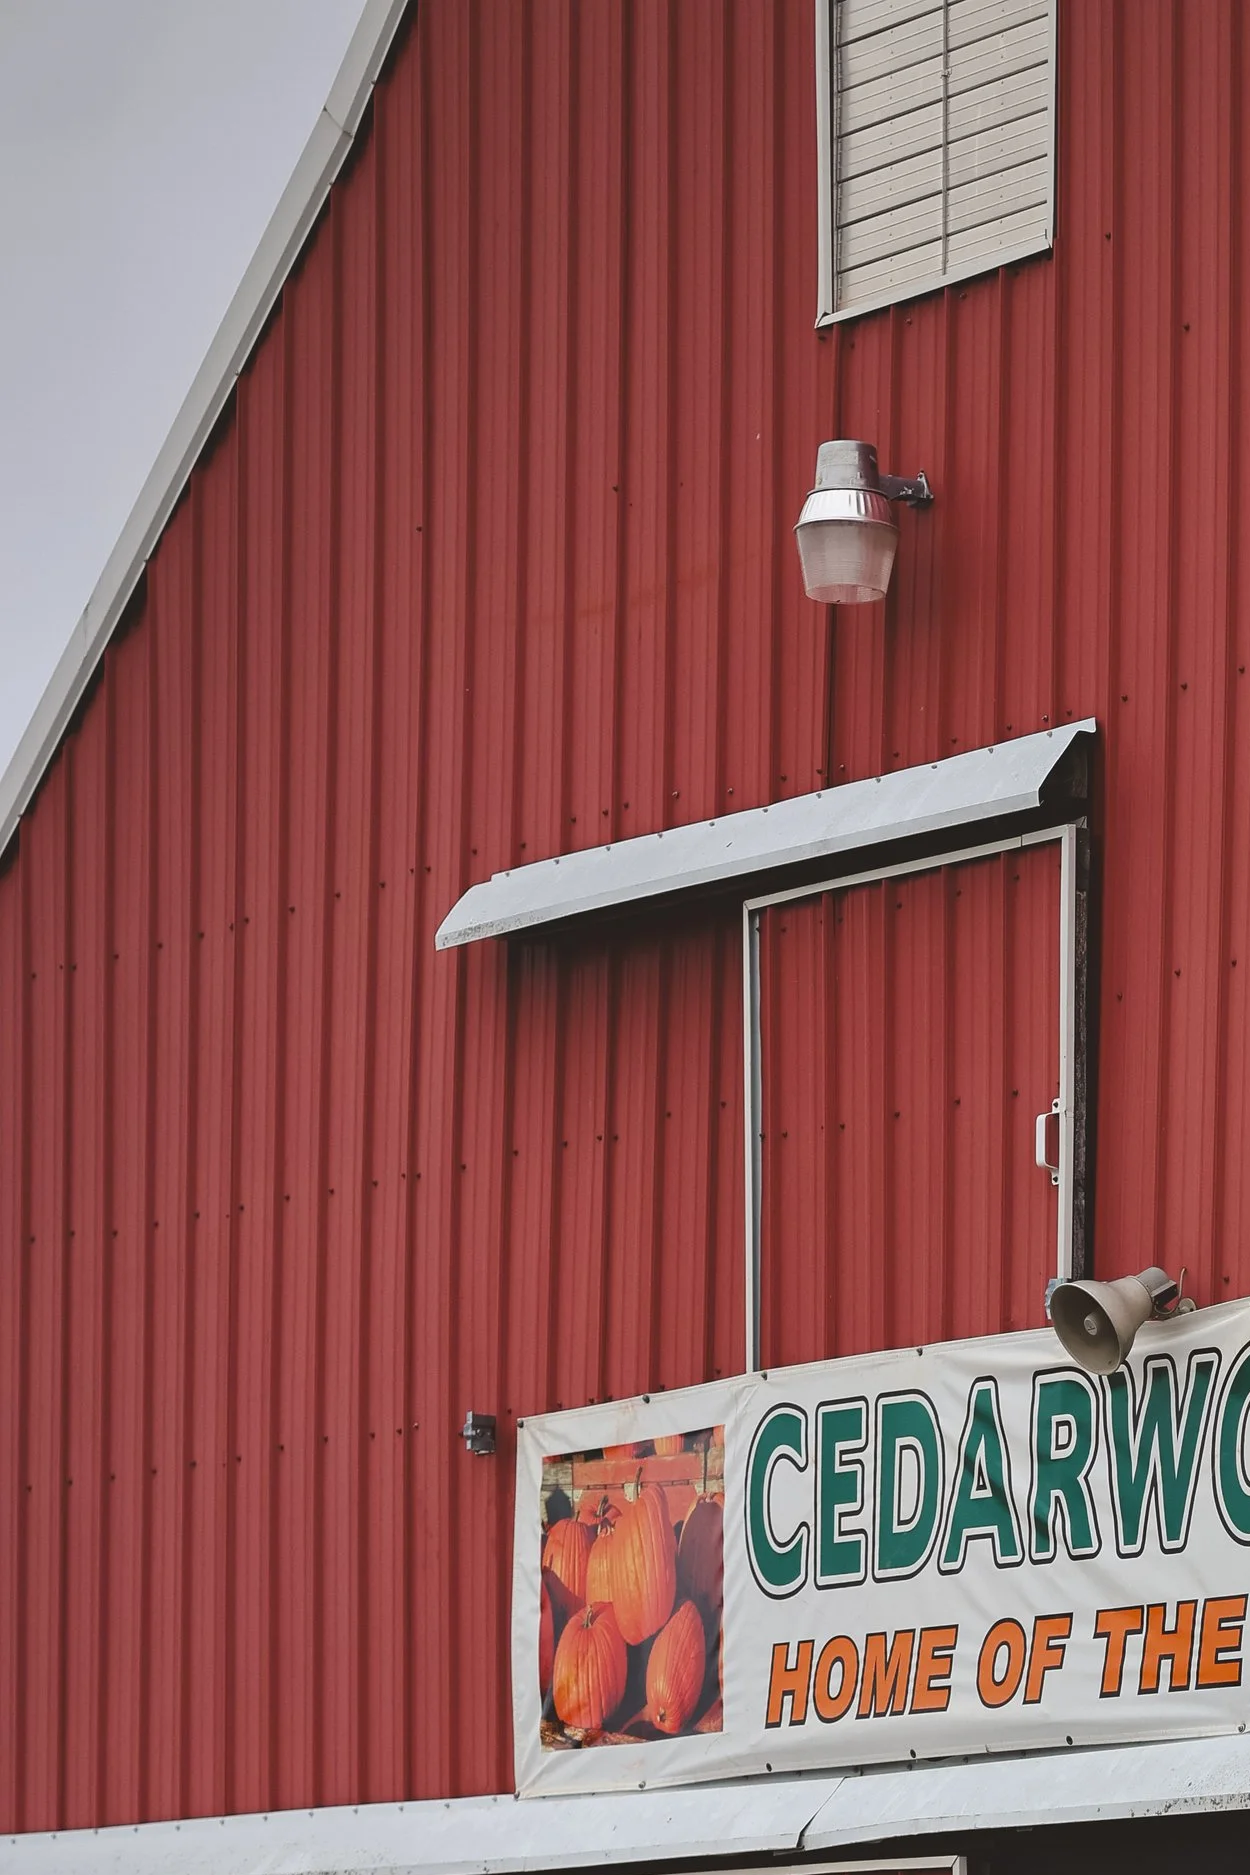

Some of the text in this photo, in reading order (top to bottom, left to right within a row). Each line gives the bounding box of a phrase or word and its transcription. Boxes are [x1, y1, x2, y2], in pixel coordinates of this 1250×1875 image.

[765, 1624, 959, 1729] HOME
[976, 1613, 1073, 1708] OF
[1093, 1594, 1249, 1698] THE
